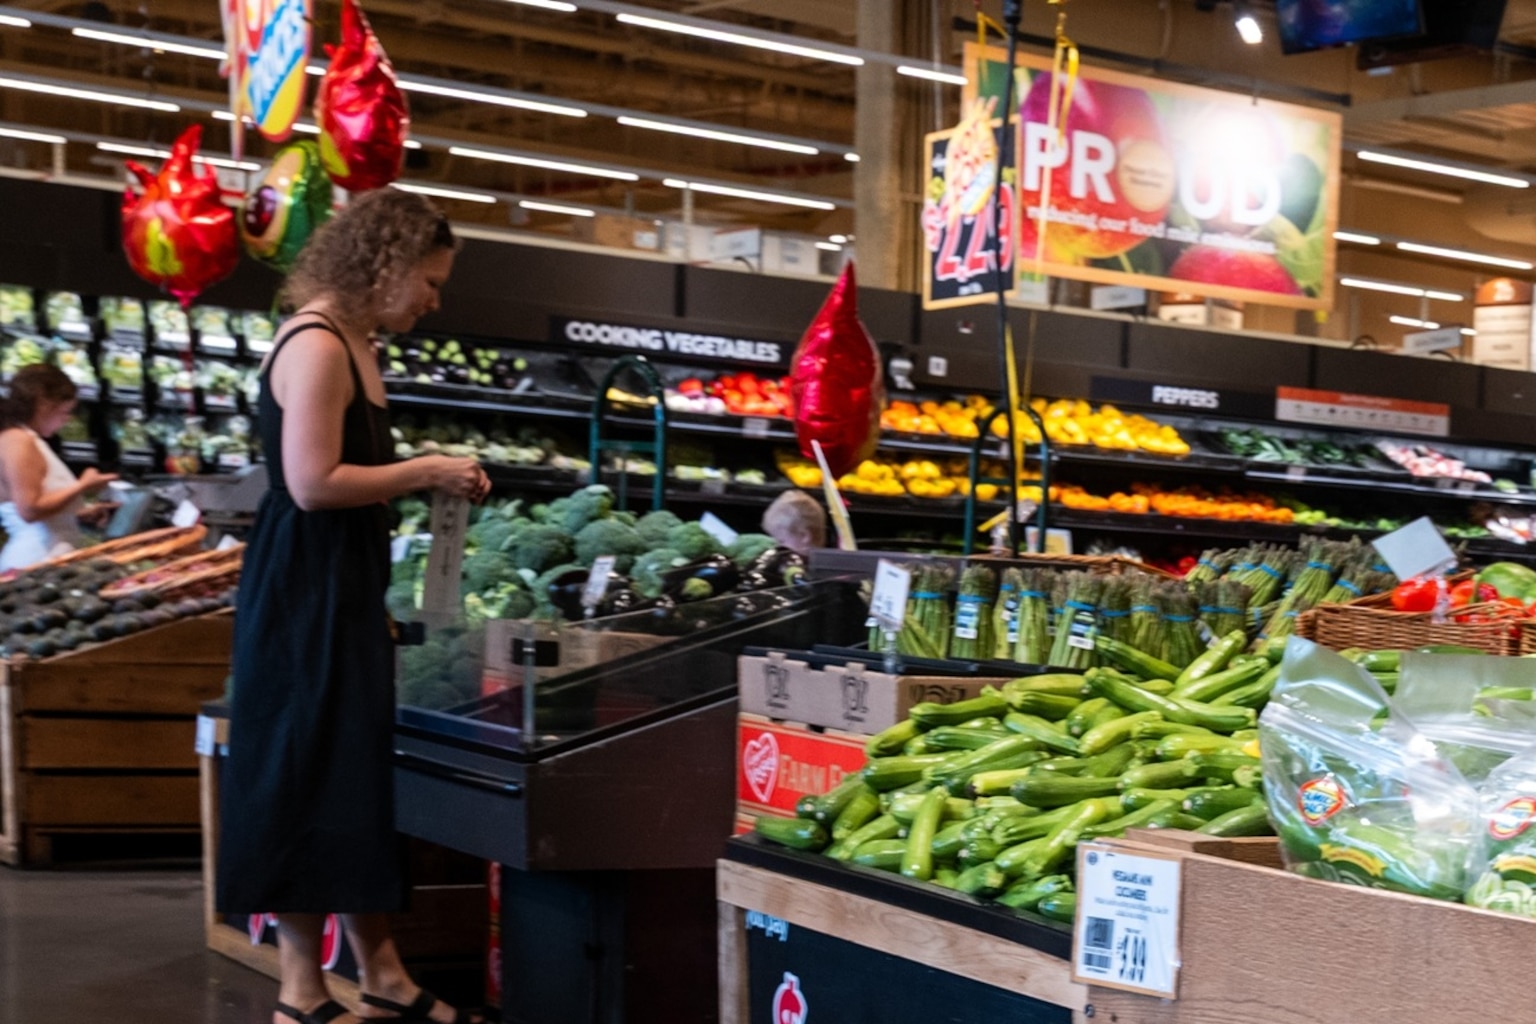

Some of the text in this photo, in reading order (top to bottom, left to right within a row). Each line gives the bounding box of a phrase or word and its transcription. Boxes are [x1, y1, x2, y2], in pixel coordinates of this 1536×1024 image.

[565, 321, 780, 362] COOKING VEGETABLES
[1152, 385, 1219, 409] PEPPERS
